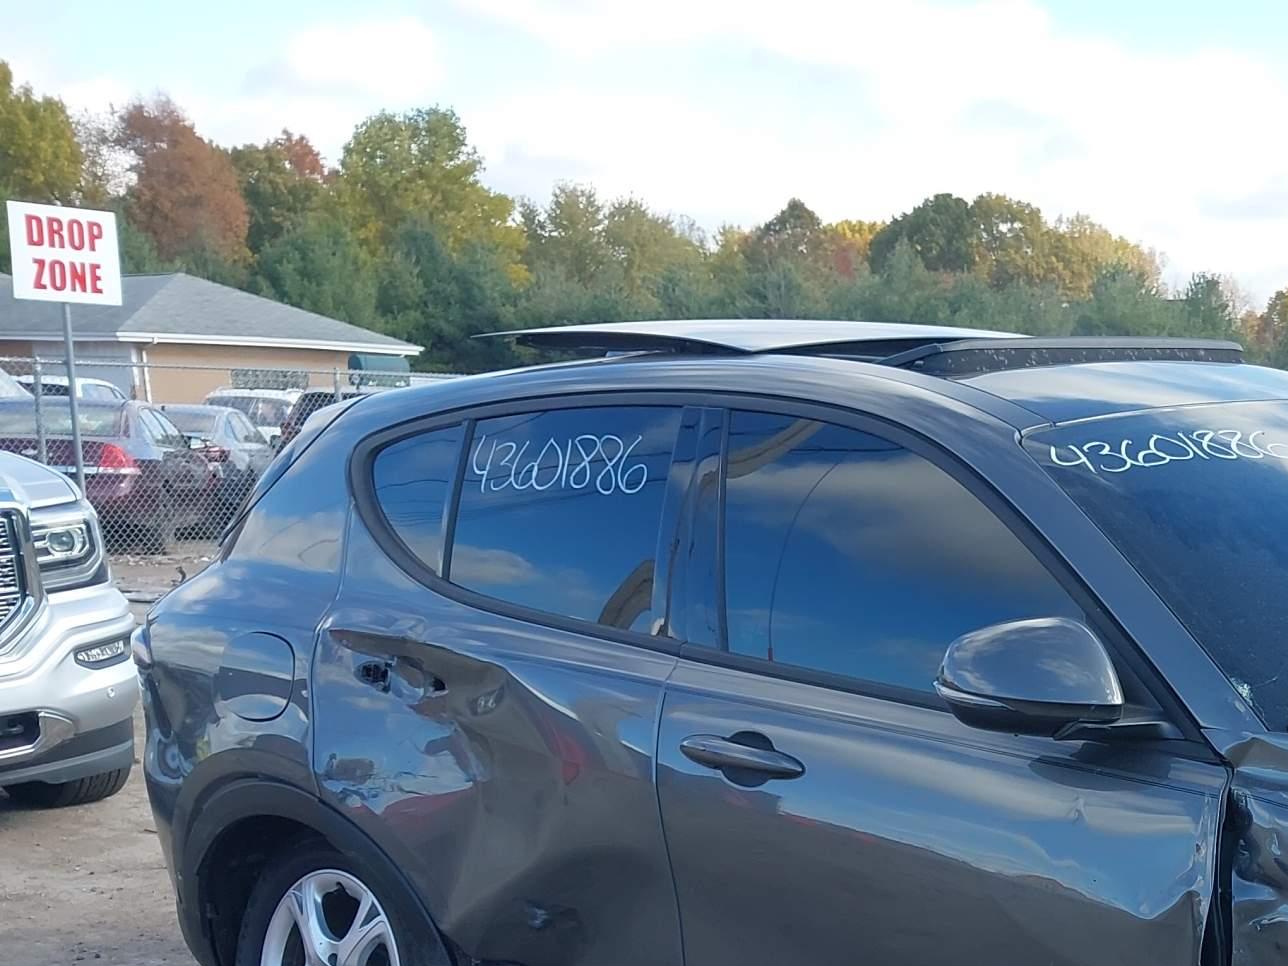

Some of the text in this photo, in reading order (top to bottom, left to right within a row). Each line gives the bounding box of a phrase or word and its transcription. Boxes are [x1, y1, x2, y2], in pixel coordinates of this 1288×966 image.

[24, 213, 104, 252] DROP
[31, 257, 104, 294] ZONE
[472, 433, 648, 495] 43601886
